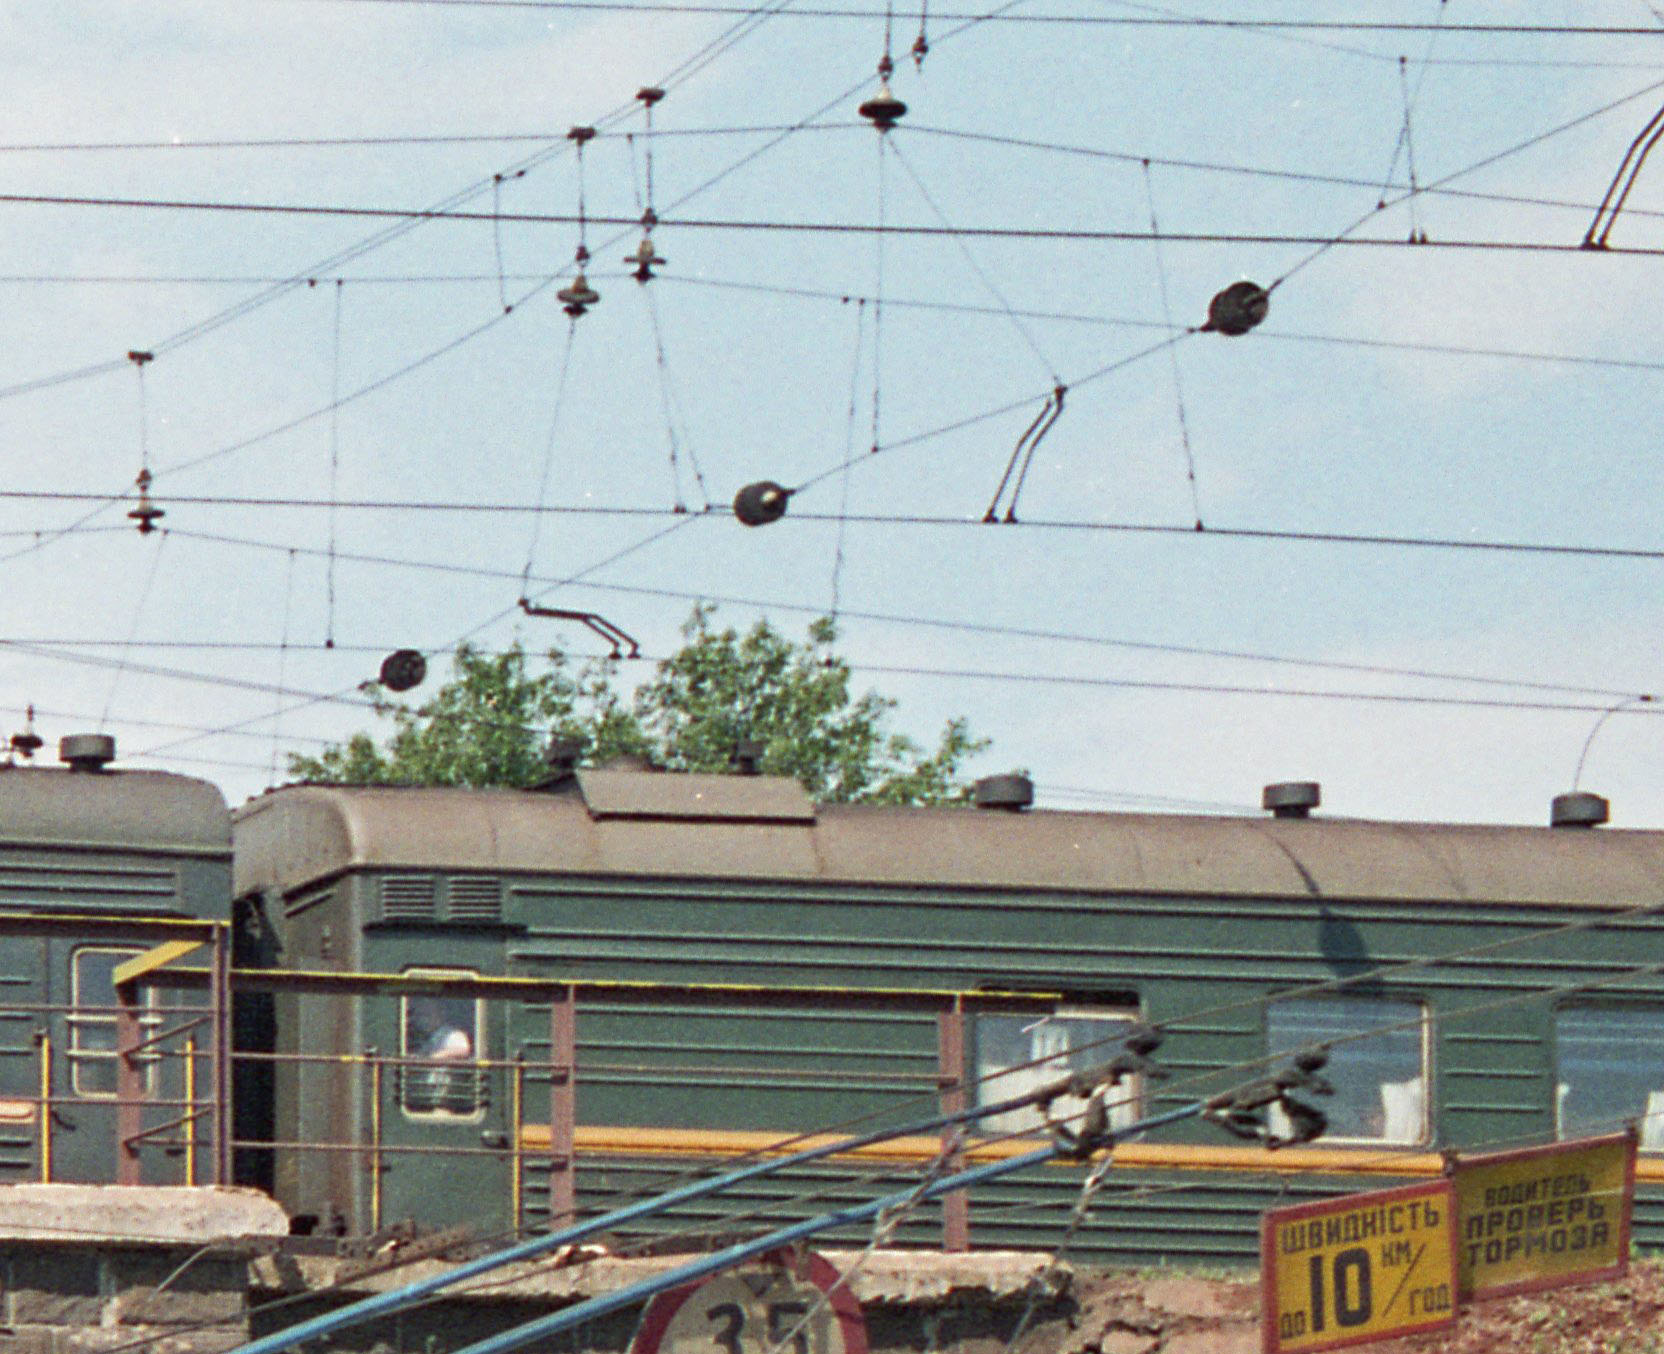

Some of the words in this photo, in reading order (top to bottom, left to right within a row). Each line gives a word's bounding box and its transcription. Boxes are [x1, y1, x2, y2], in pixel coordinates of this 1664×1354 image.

[1485, 1174, 1591, 1208] ВОДИТЕЛЬ
[1467, 1197, 1605, 1239] ПРОВЕРЬ
[1467, 1222, 1610, 1266] ТОРМОЗА
[1280, 1310, 1306, 1339] ДО
[1310, 1247, 1372, 1333] 10
